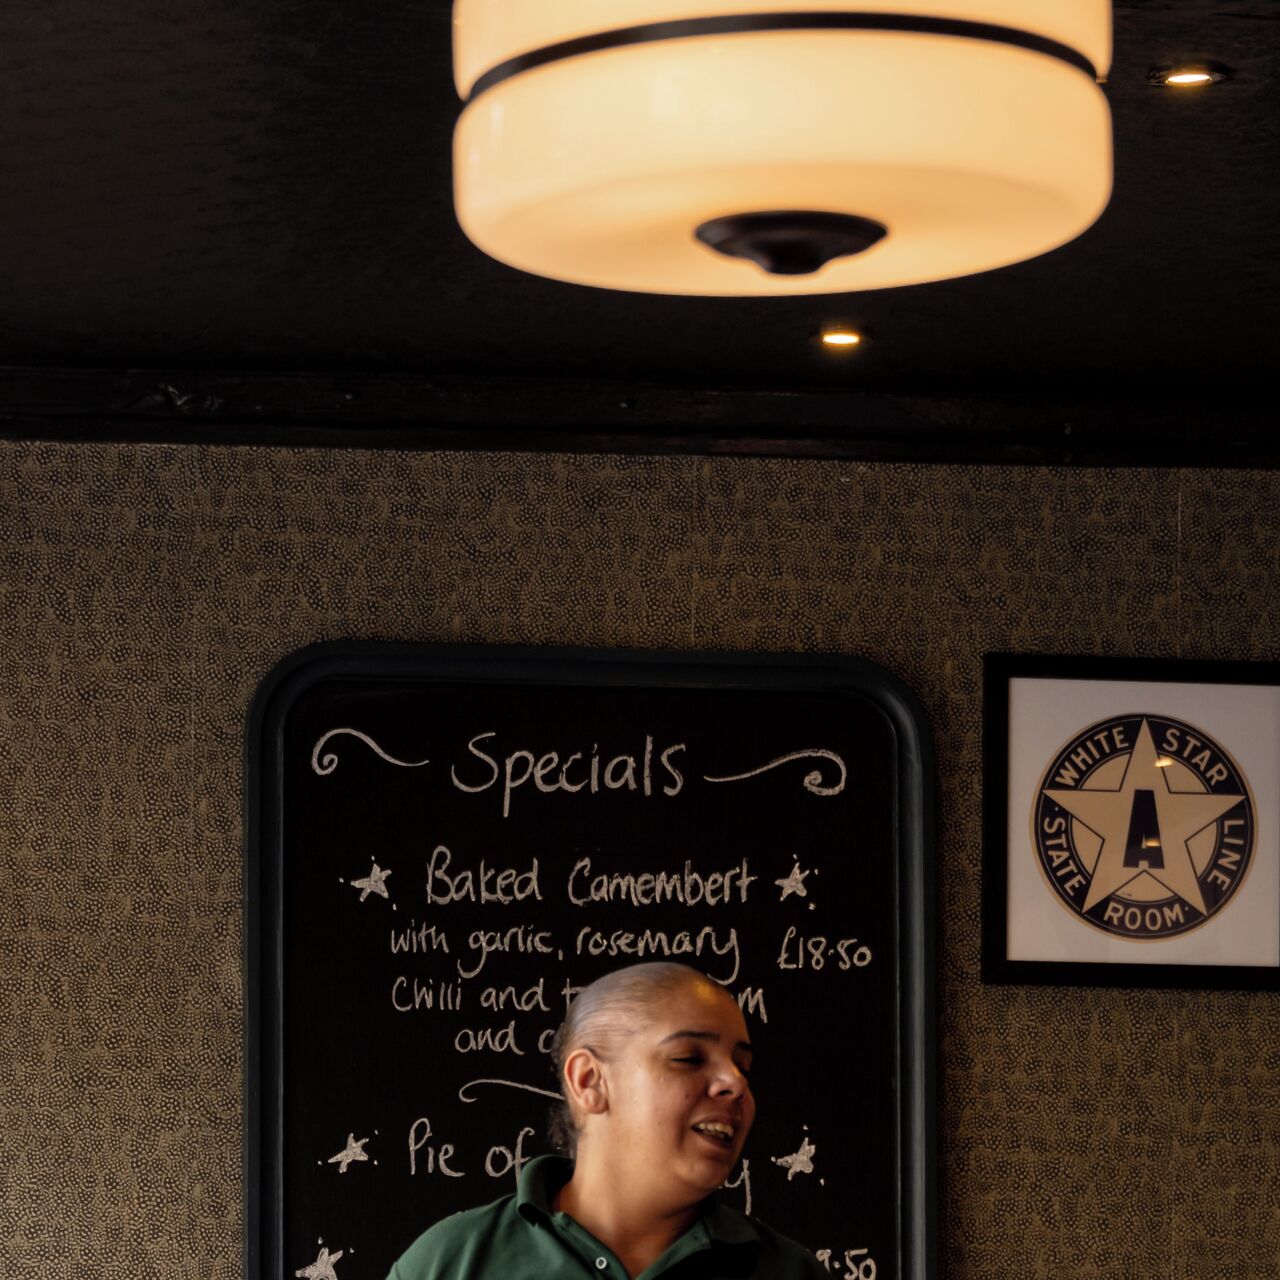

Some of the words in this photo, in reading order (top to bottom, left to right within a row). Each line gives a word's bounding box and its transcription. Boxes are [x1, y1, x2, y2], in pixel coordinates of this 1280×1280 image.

[451, 732, 686, 818] Specials
[1055, 726, 1129, 788] WHITE
[1162, 728, 1228, 787] STAR
[1207, 819, 1245, 892] LINE
[426, 845, 542, 905] Baked
[567, 857, 758, 907] Camembert
[1044, 817, 1086, 897] STATE
[1103, 903, 1185, 931] ROOM
[391, 921, 450, 955] with
[457, 925, 563, 978] garlic,
[576, 926, 740, 984] rosemary
[776, 926, 872, 971] £18.50
[392, 976, 462, 1012] Chilli
[480, 977, 551, 1012] and
[454, 1020, 525, 1056] and
[408, 1117, 465, 1178] Pie
[484, 1127, 535, 1179] of
